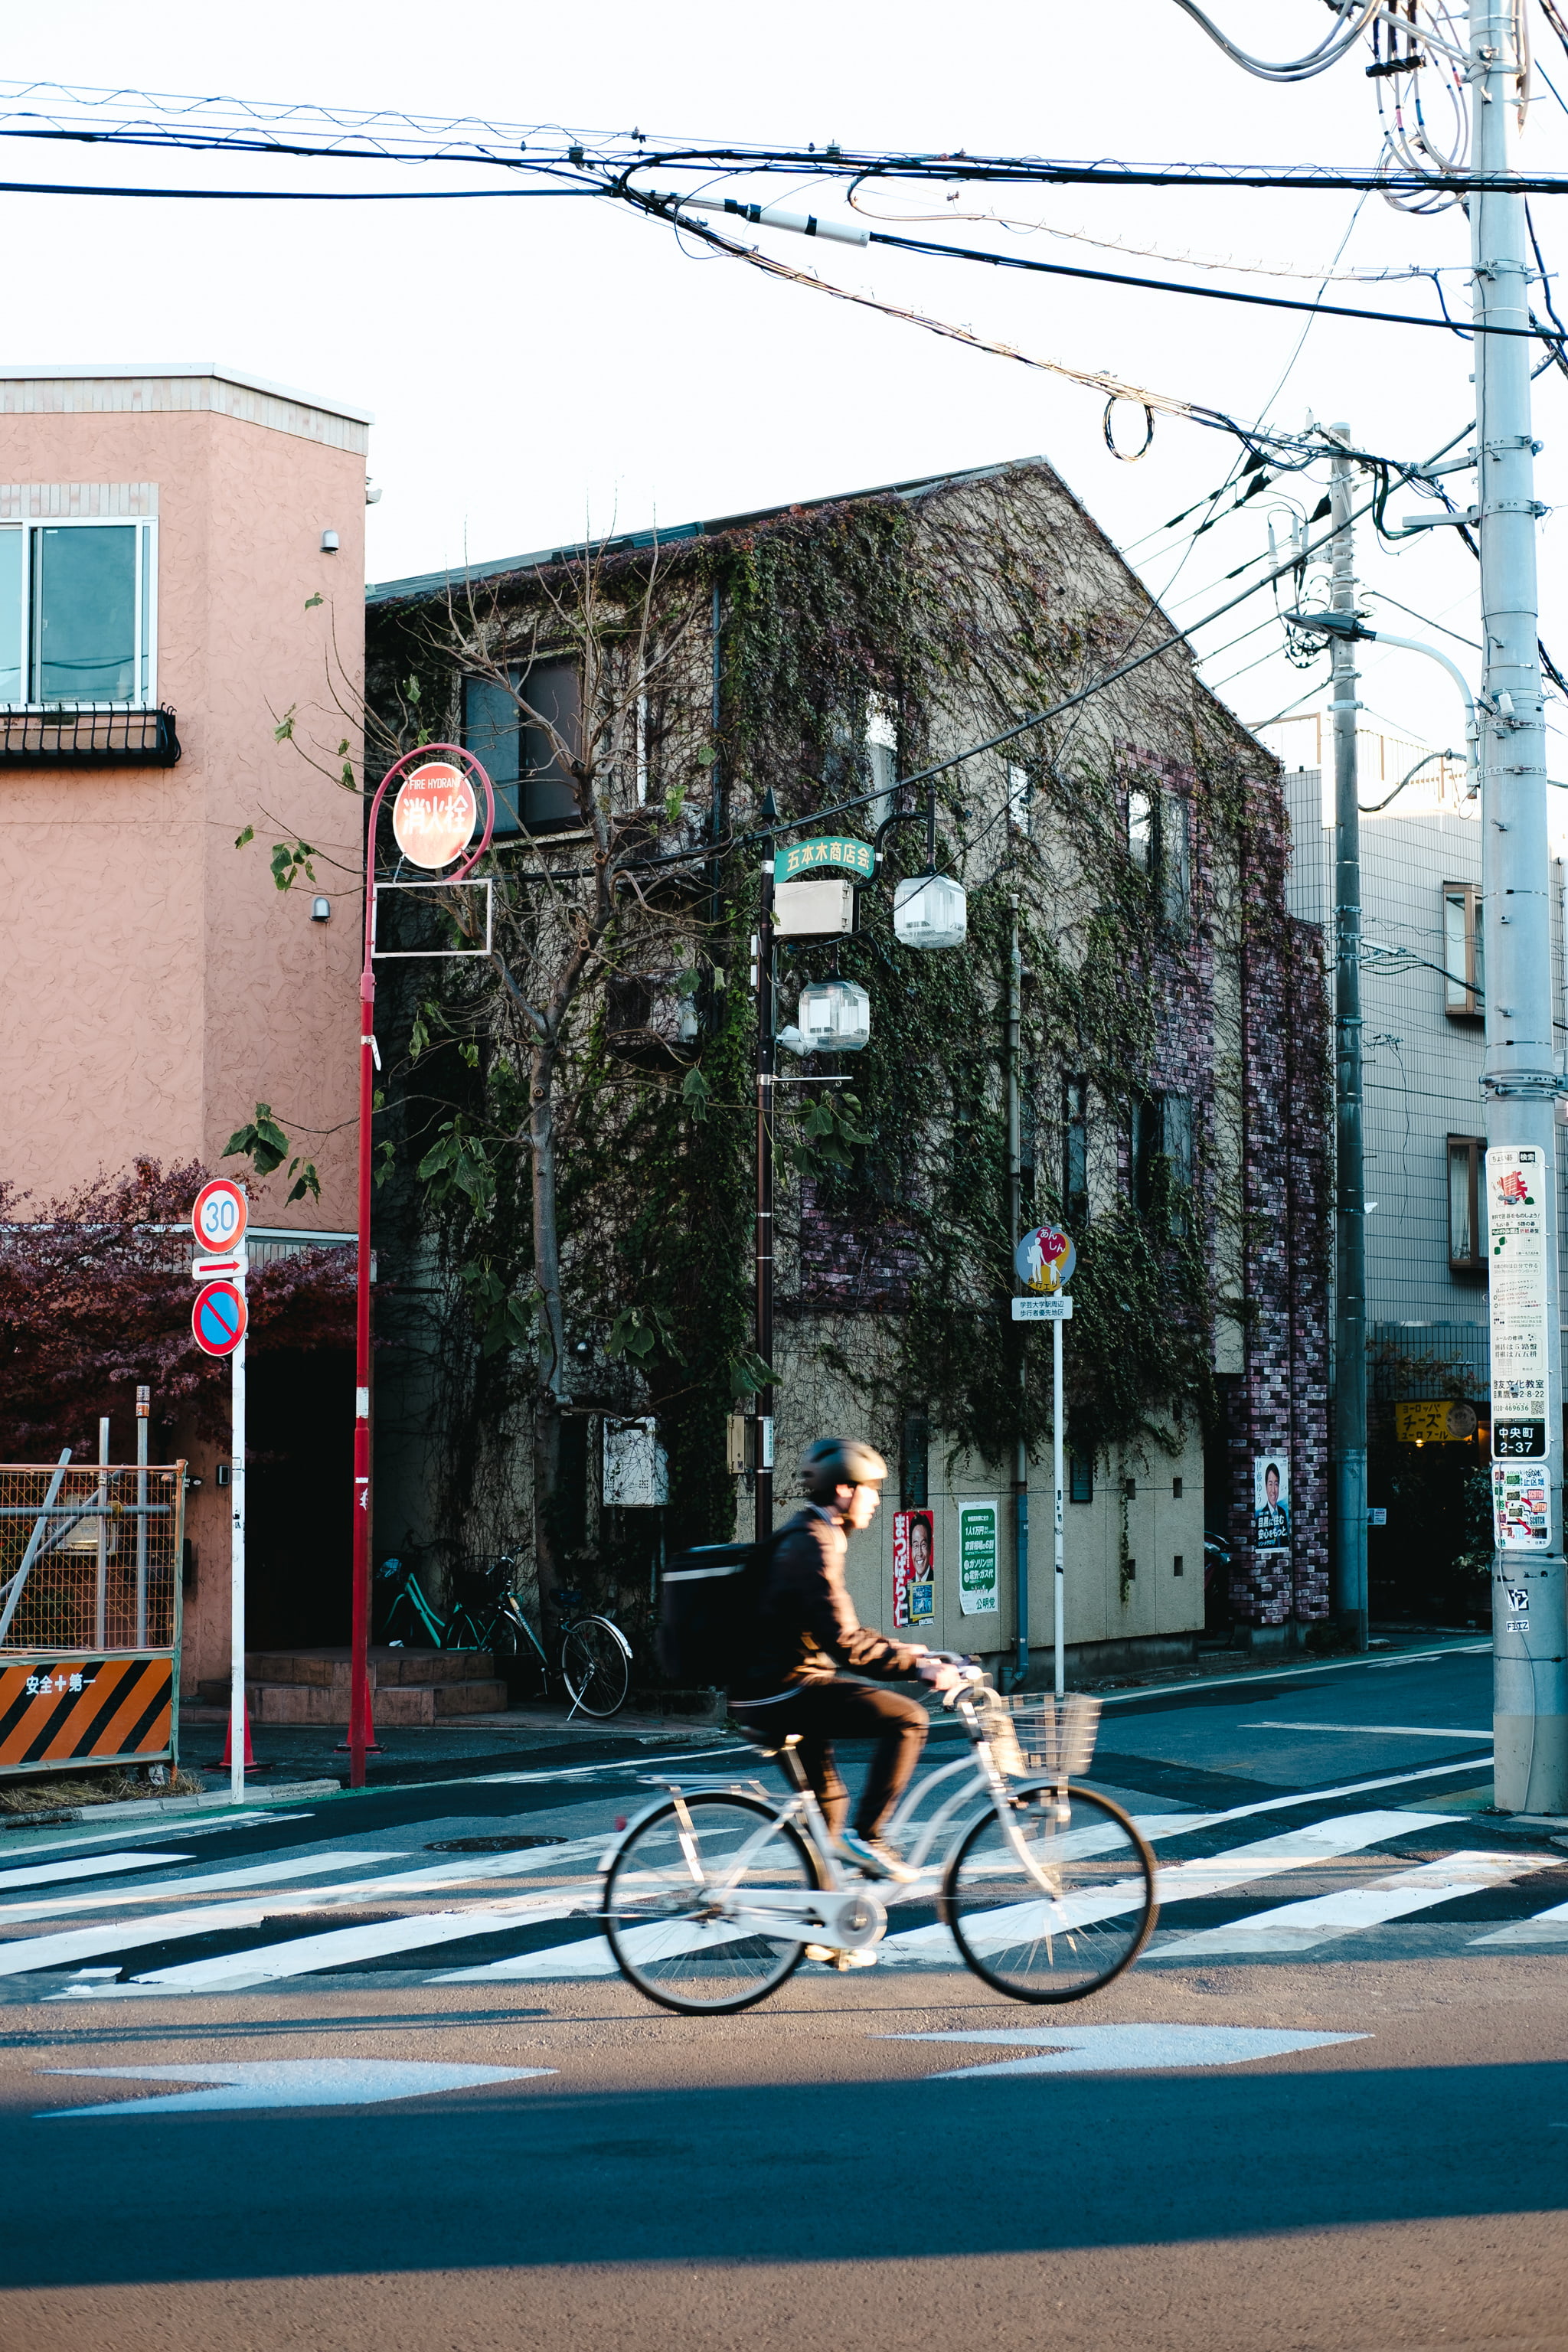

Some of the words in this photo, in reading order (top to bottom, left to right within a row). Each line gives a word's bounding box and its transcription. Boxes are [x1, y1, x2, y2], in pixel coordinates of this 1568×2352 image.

[410, 779, 426, 790] FIRE
[428, 777, 461, 789] HYDRANT
[402, 794, 469, 835] 消火栓
[786, 841, 871, 872] 五本木商店会
[206, 1200, 234, 1233] 30
[1040, 1229, 1057, 1240] あん
[1049, 1241, 1066, 1253] しん
[1027, 1276, 1066, 1291] 歩行エリア
[1020, 1300, 1064, 1308] 学芸大学駅周辺
[1402, 1403, 1441, 1413] ヨーロッパ
[1403, 1413, 1442, 1431] チーズ
[1498, 1427, 1534, 1439] 中央町
[1500, 1442, 1533, 1453] 2-37
[1258, 1514, 1285, 1528] 目黒に住む
[965, 1526, 985, 1536] 1人1万円
[969, 1558, 987, 1569] ガソリン
[894, 1514, 909, 1627] まつばら仁
[976, 1596, 995, 1610] 公明党
